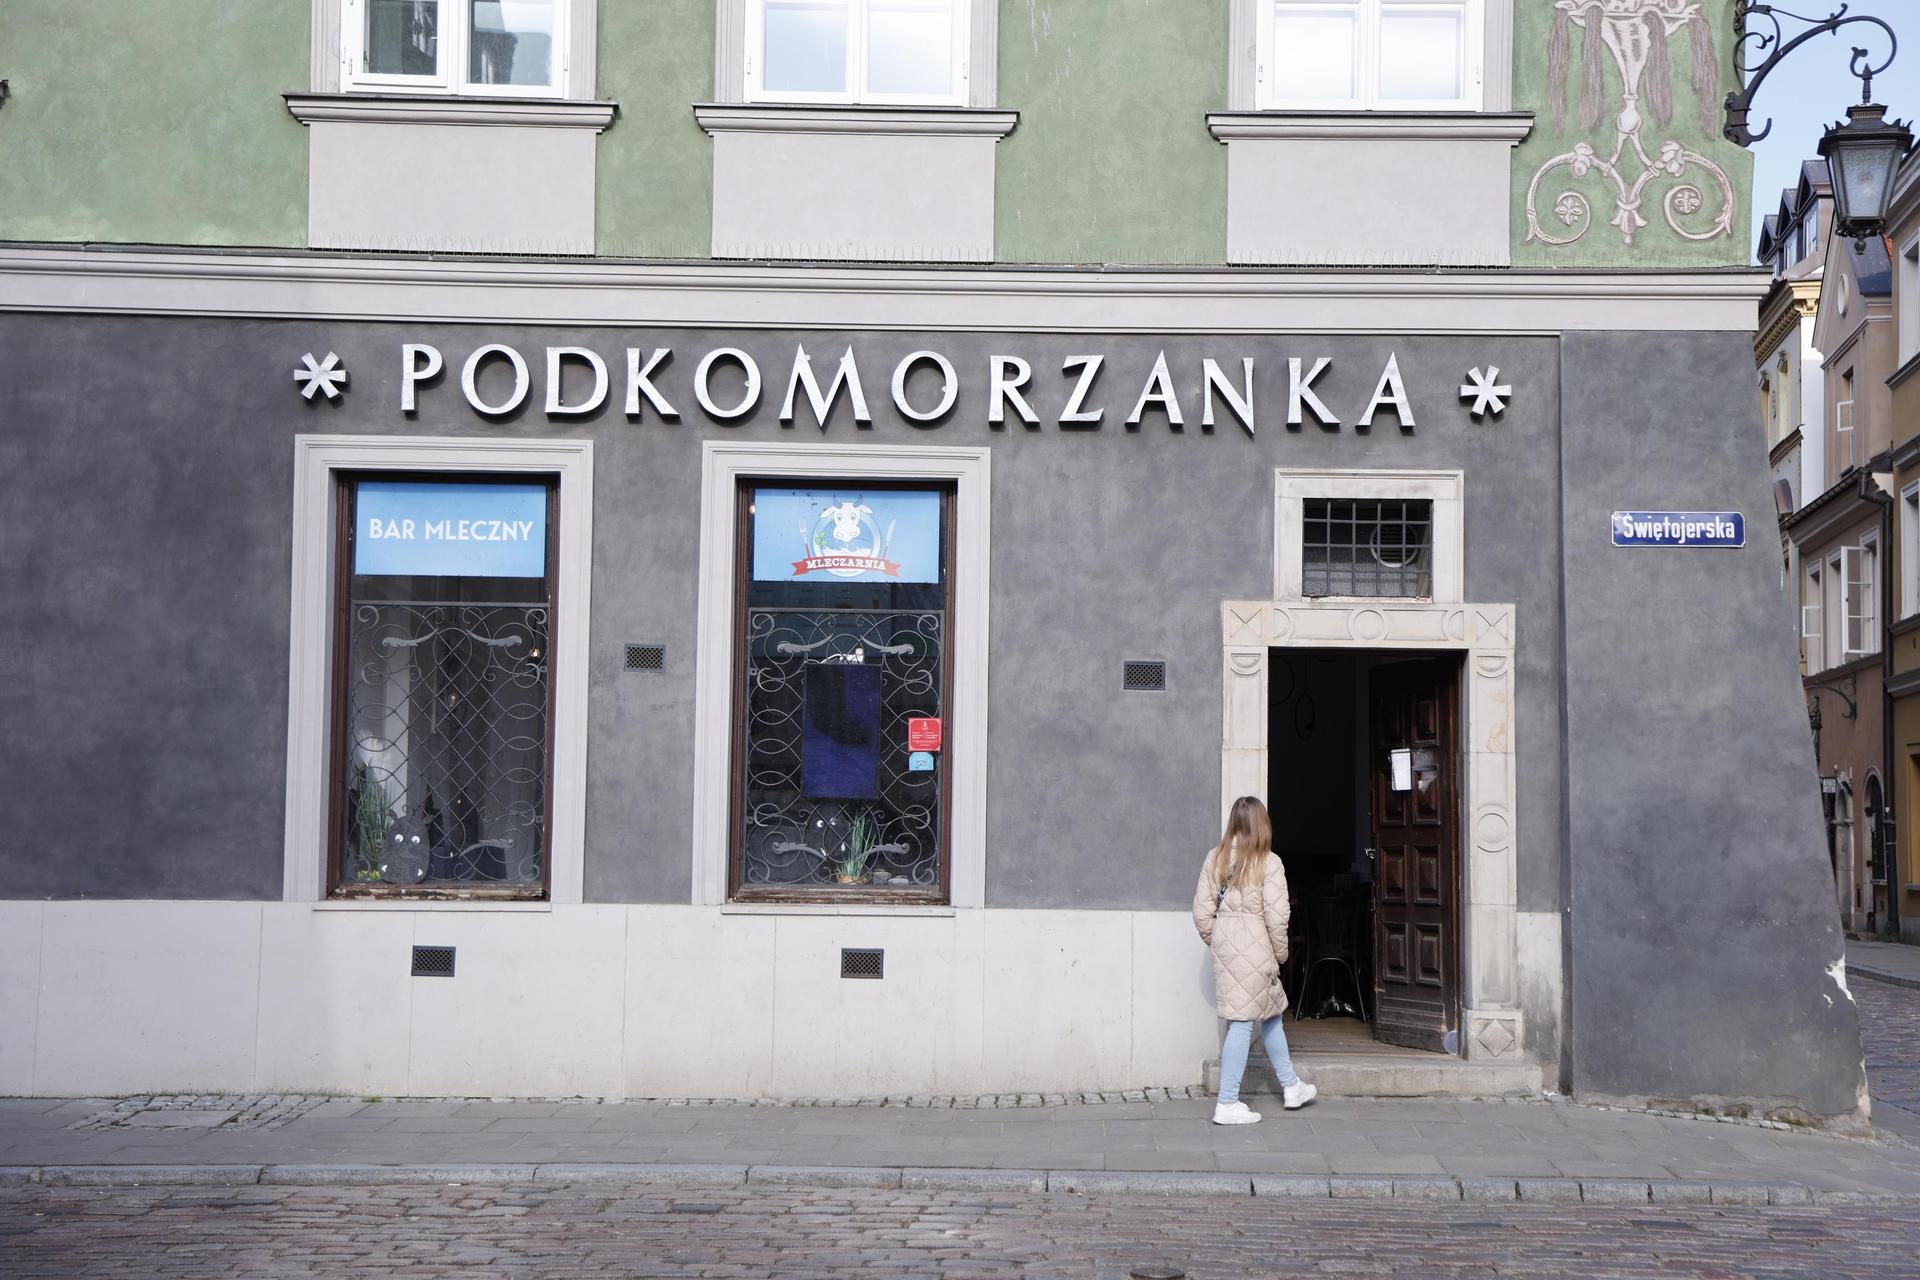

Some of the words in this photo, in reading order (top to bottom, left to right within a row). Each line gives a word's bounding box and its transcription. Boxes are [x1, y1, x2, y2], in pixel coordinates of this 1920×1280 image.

[400, 343, 1416, 434] PODKOMORZANKA
[369, 518, 416, 540] BAR
[425, 520, 534, 541] MLECZNY
[1622, 512, 1735, 544] Świętojerska
[806, 557, 887, 569] MLECZARNIA
